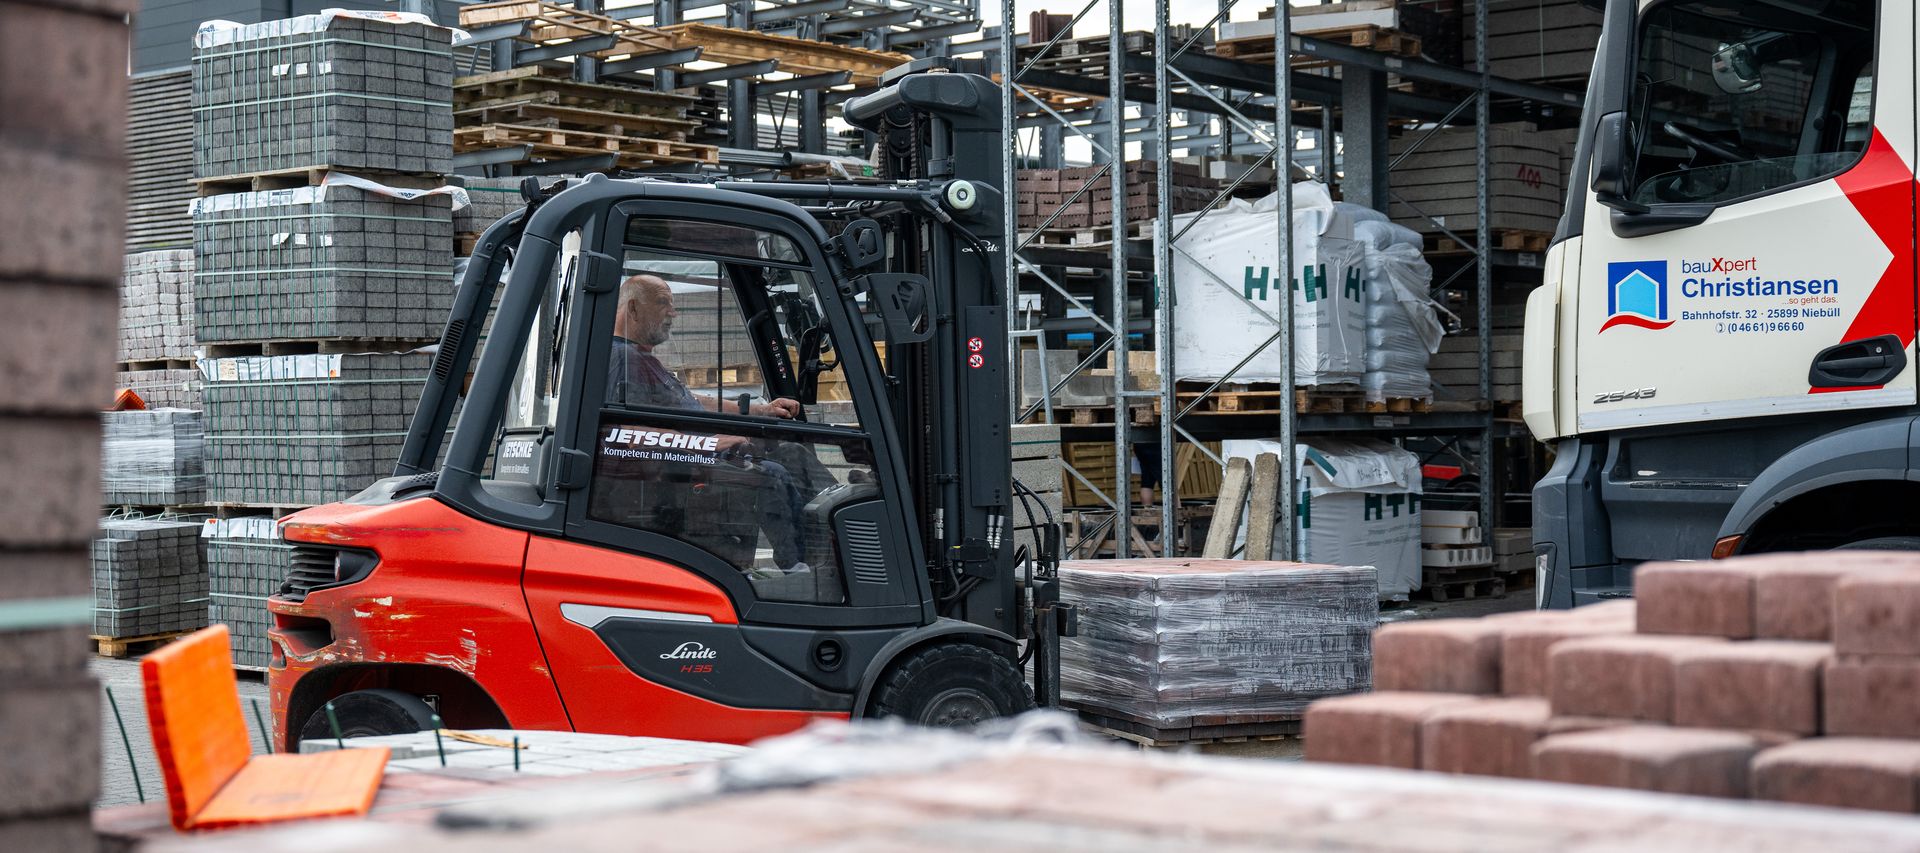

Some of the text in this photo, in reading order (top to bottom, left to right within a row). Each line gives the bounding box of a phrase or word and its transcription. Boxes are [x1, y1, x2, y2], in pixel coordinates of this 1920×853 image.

[1682, 256, 1757, 275] bauXpert
[1244, 263, 1328, 302] HH
[1681, 276, 1838, 298] Christiansen
[1800, 296, 1819, 306] geht
[1820, 295, 1839, 304] das.
[1682, 310, 1742, 320] Bahnhofstr.
[1745, 309, 1757, 319] 32
[1767, 308, 1799, 319] 25899
[1802, 307, 1841, 318] Niebüll
[1593, 387, 1656, 404] 2543
[605, 428, 719, 451] JETSCHKE
[603, 447, 715, 465] Kompetenz im Materialfluss
[660, 641, 717, 660] Linde
